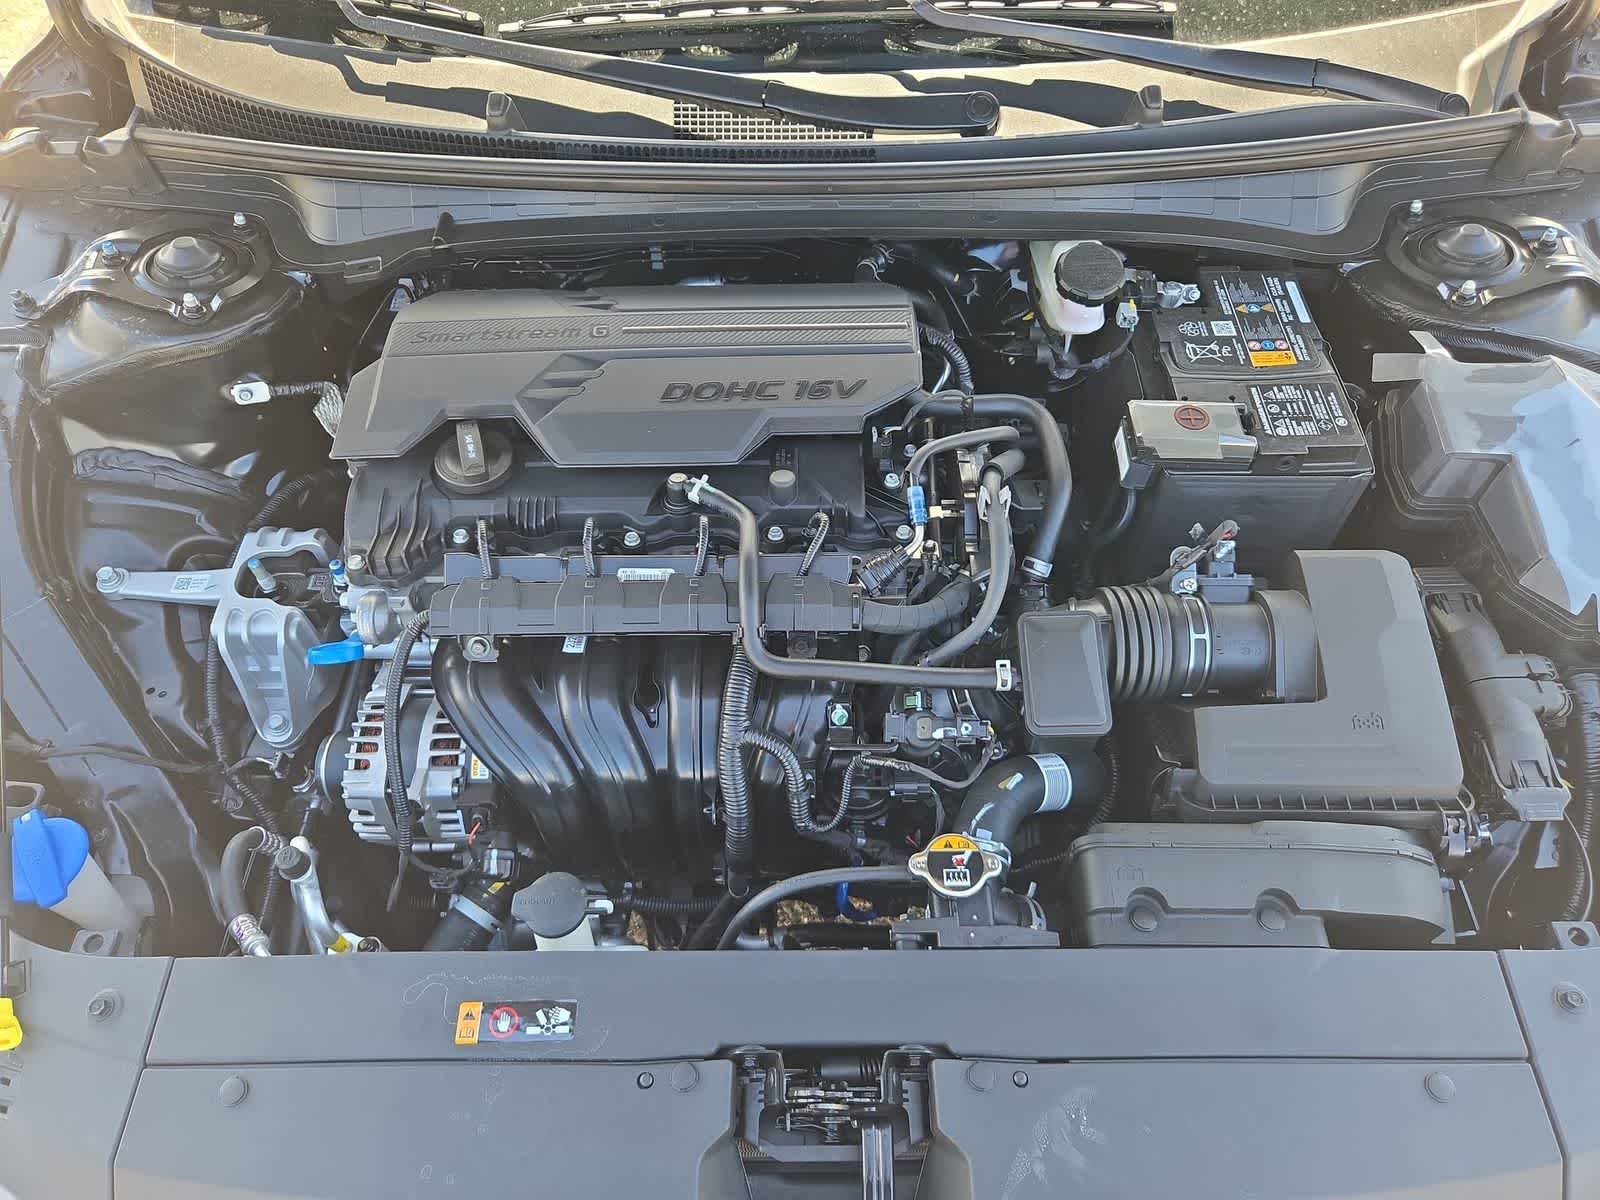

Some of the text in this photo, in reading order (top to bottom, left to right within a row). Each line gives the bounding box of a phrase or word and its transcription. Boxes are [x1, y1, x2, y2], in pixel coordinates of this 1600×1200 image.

[410, 323, 610, 344] Smartstream G
[659, 378, 868, 402] DOHC 16V
